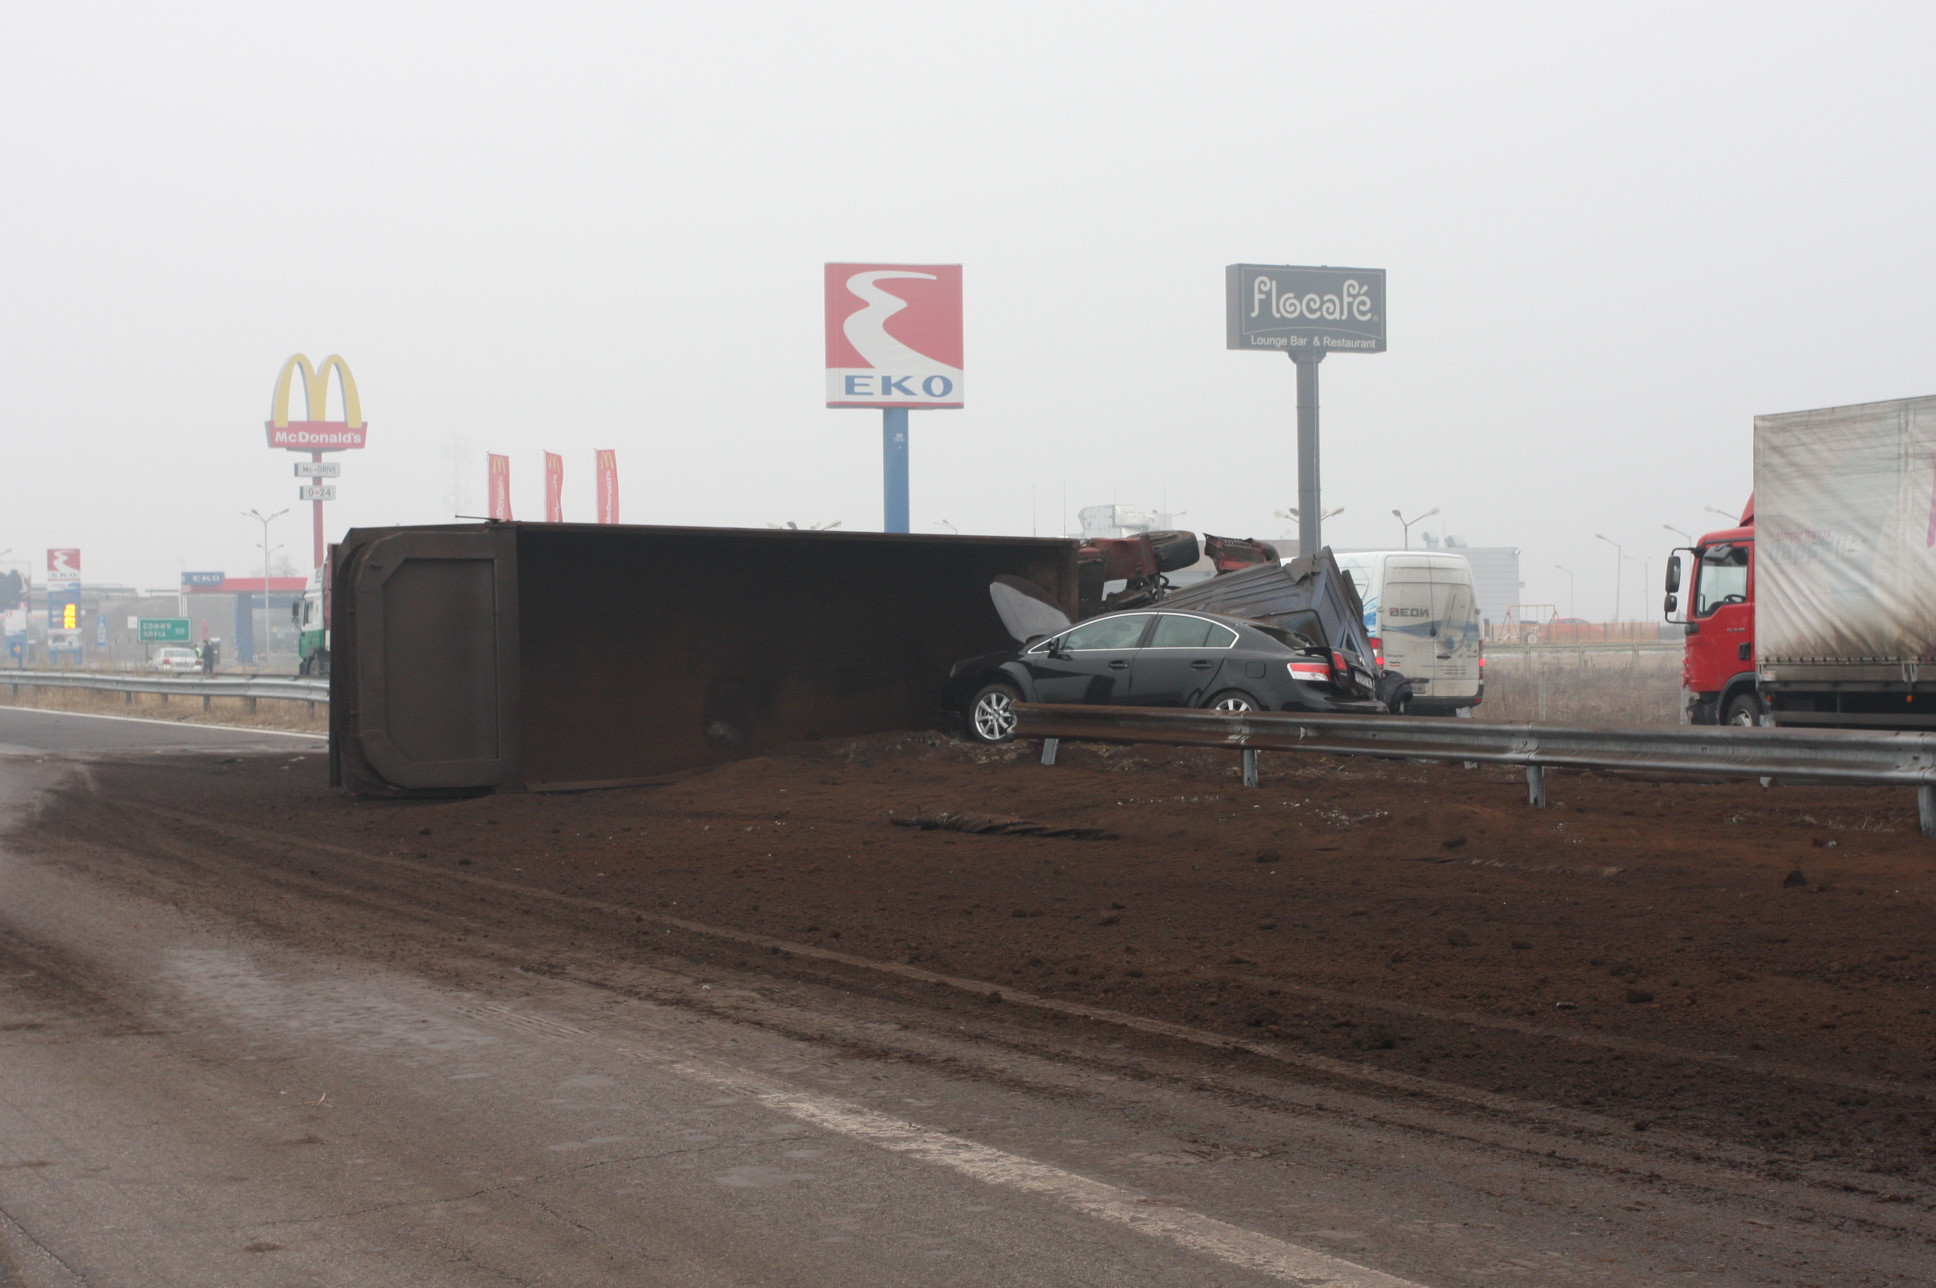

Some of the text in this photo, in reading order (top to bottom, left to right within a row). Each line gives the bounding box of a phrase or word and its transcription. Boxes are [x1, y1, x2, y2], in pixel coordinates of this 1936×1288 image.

[1251, 335, 1376, 348] Lounge Bar & Restaurant
[845, 375, 953, 398] EKO
[275, 431, 361, 443] McDonald's
